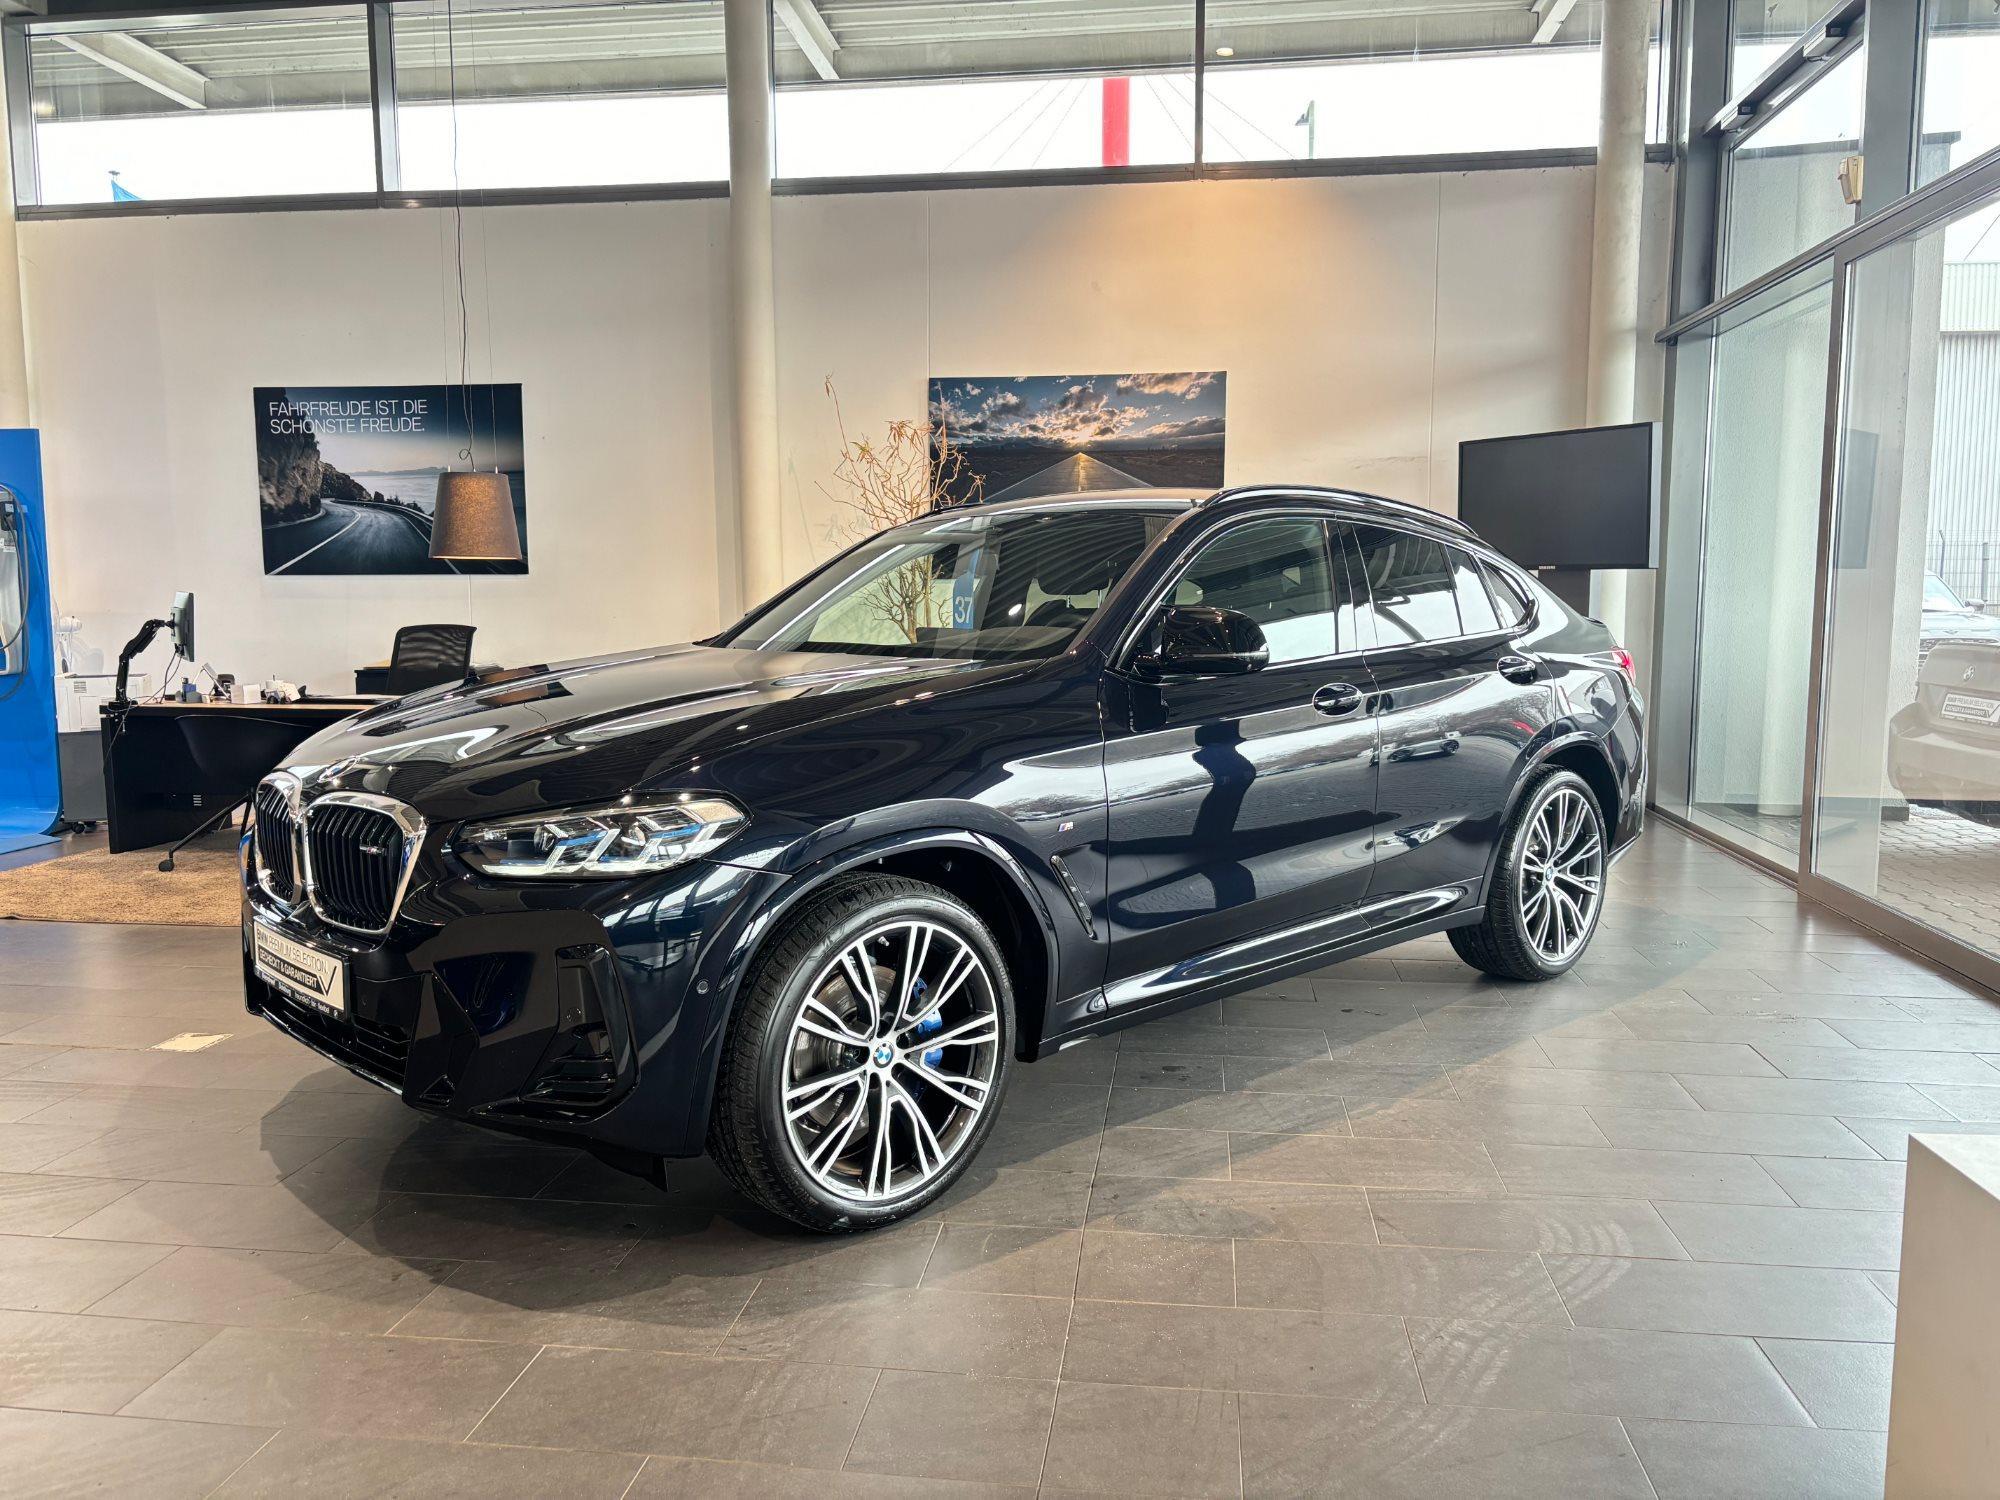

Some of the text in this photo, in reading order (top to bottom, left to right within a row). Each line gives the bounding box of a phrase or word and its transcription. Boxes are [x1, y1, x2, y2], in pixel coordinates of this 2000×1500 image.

[269, 399, 428, 417] FAHRFREUDE IST DIE
[270, 416, 425, 434] SCHÖNSTE FREUDE.
[955, 596, 973, 623] 37
[284, 964, 318, 988] GARANTIERT
